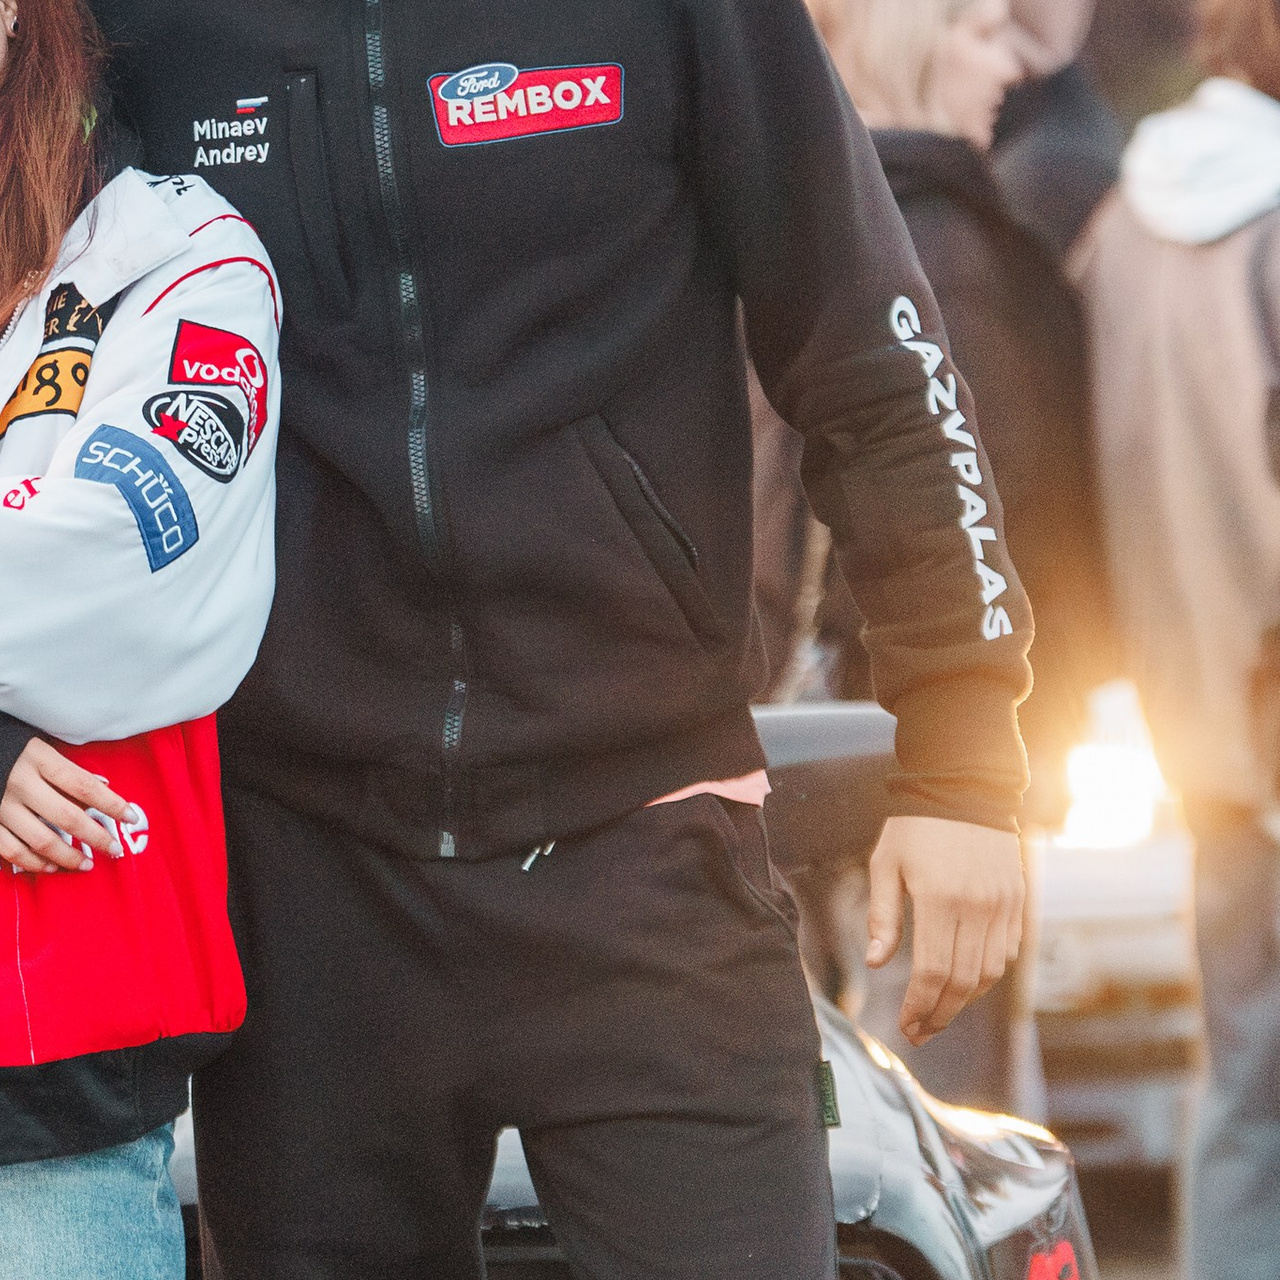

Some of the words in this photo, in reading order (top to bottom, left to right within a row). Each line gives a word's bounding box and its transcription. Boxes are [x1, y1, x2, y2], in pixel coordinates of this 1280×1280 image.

[456, 71, 501, 97] Ford
[446, 75, 611, 126] REMBOX
[193, 117, 268, 142] Minaev
[193, 142, 270, 168] Andrey
[81, 440, 184, 554] SCHÜCO
